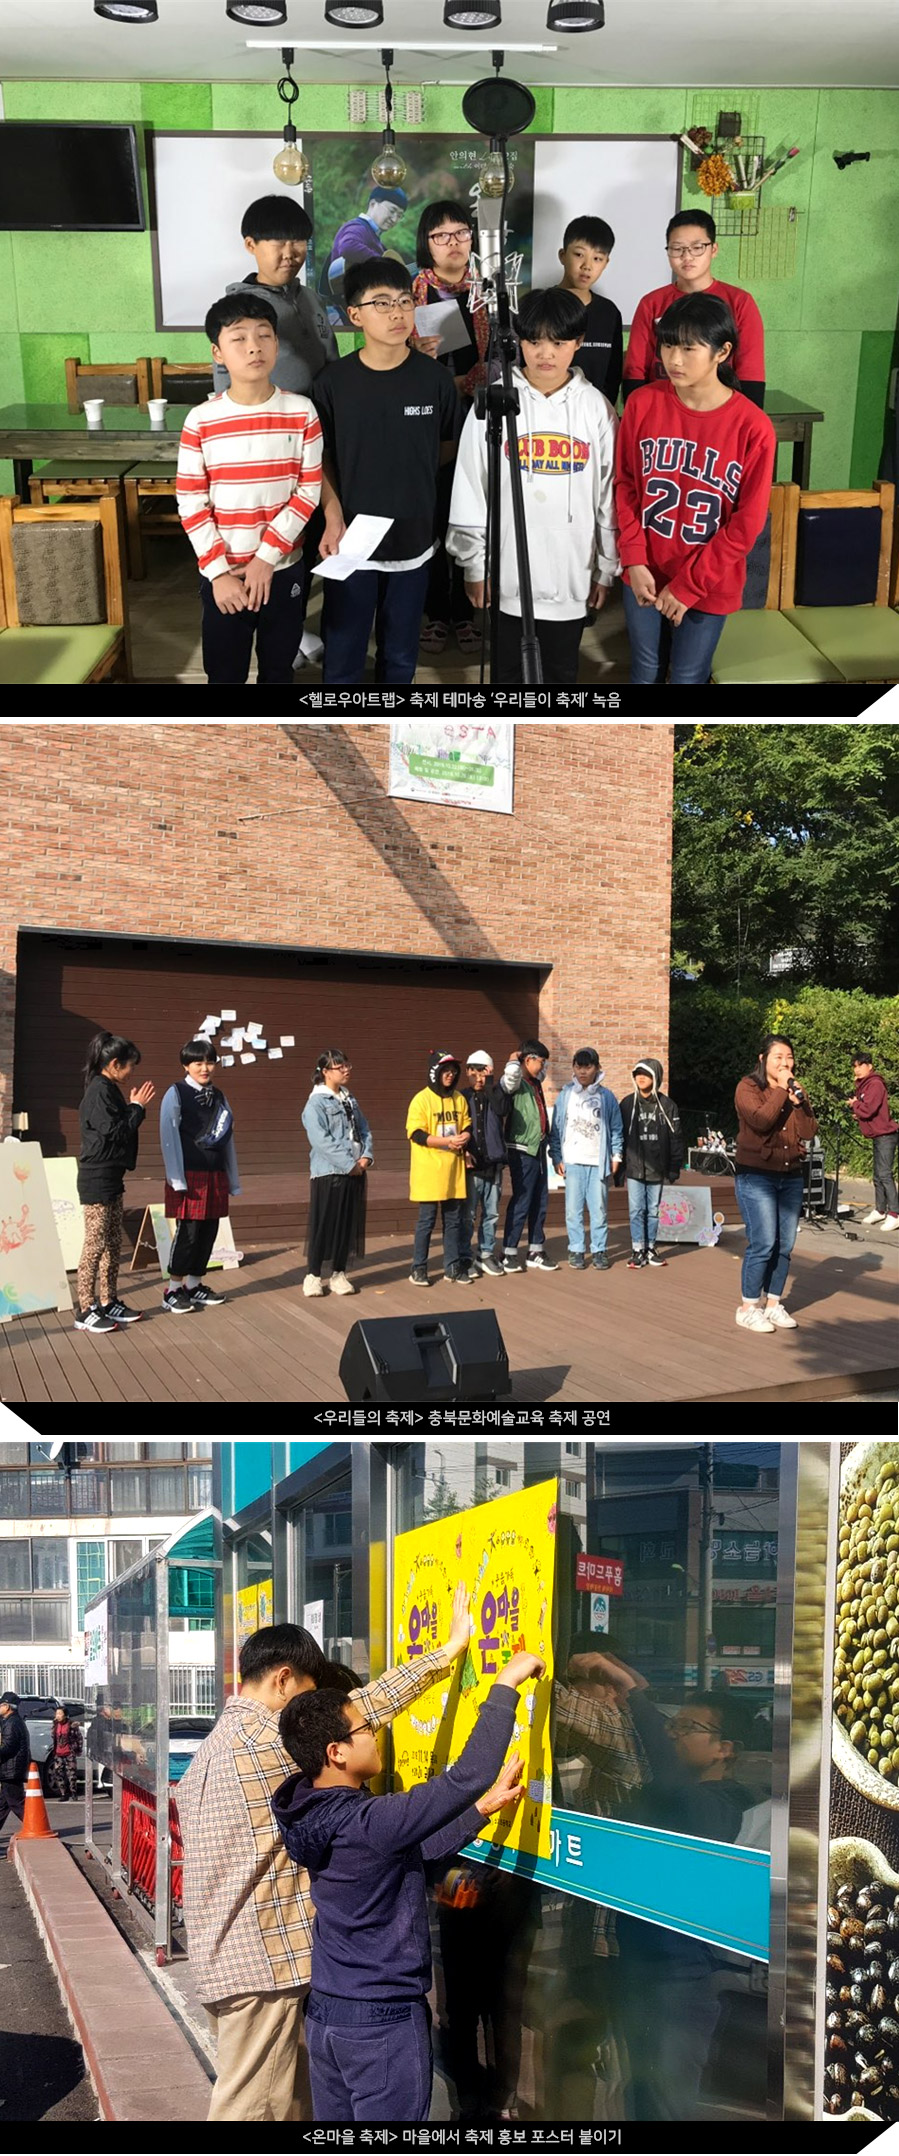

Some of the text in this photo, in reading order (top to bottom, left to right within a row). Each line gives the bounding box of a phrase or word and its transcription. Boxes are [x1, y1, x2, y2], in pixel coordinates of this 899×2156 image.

[449, 150, 477, 161] 안의현
[640, 437, 743, 503] BULLS
[642, 477, 722, 545] 23
